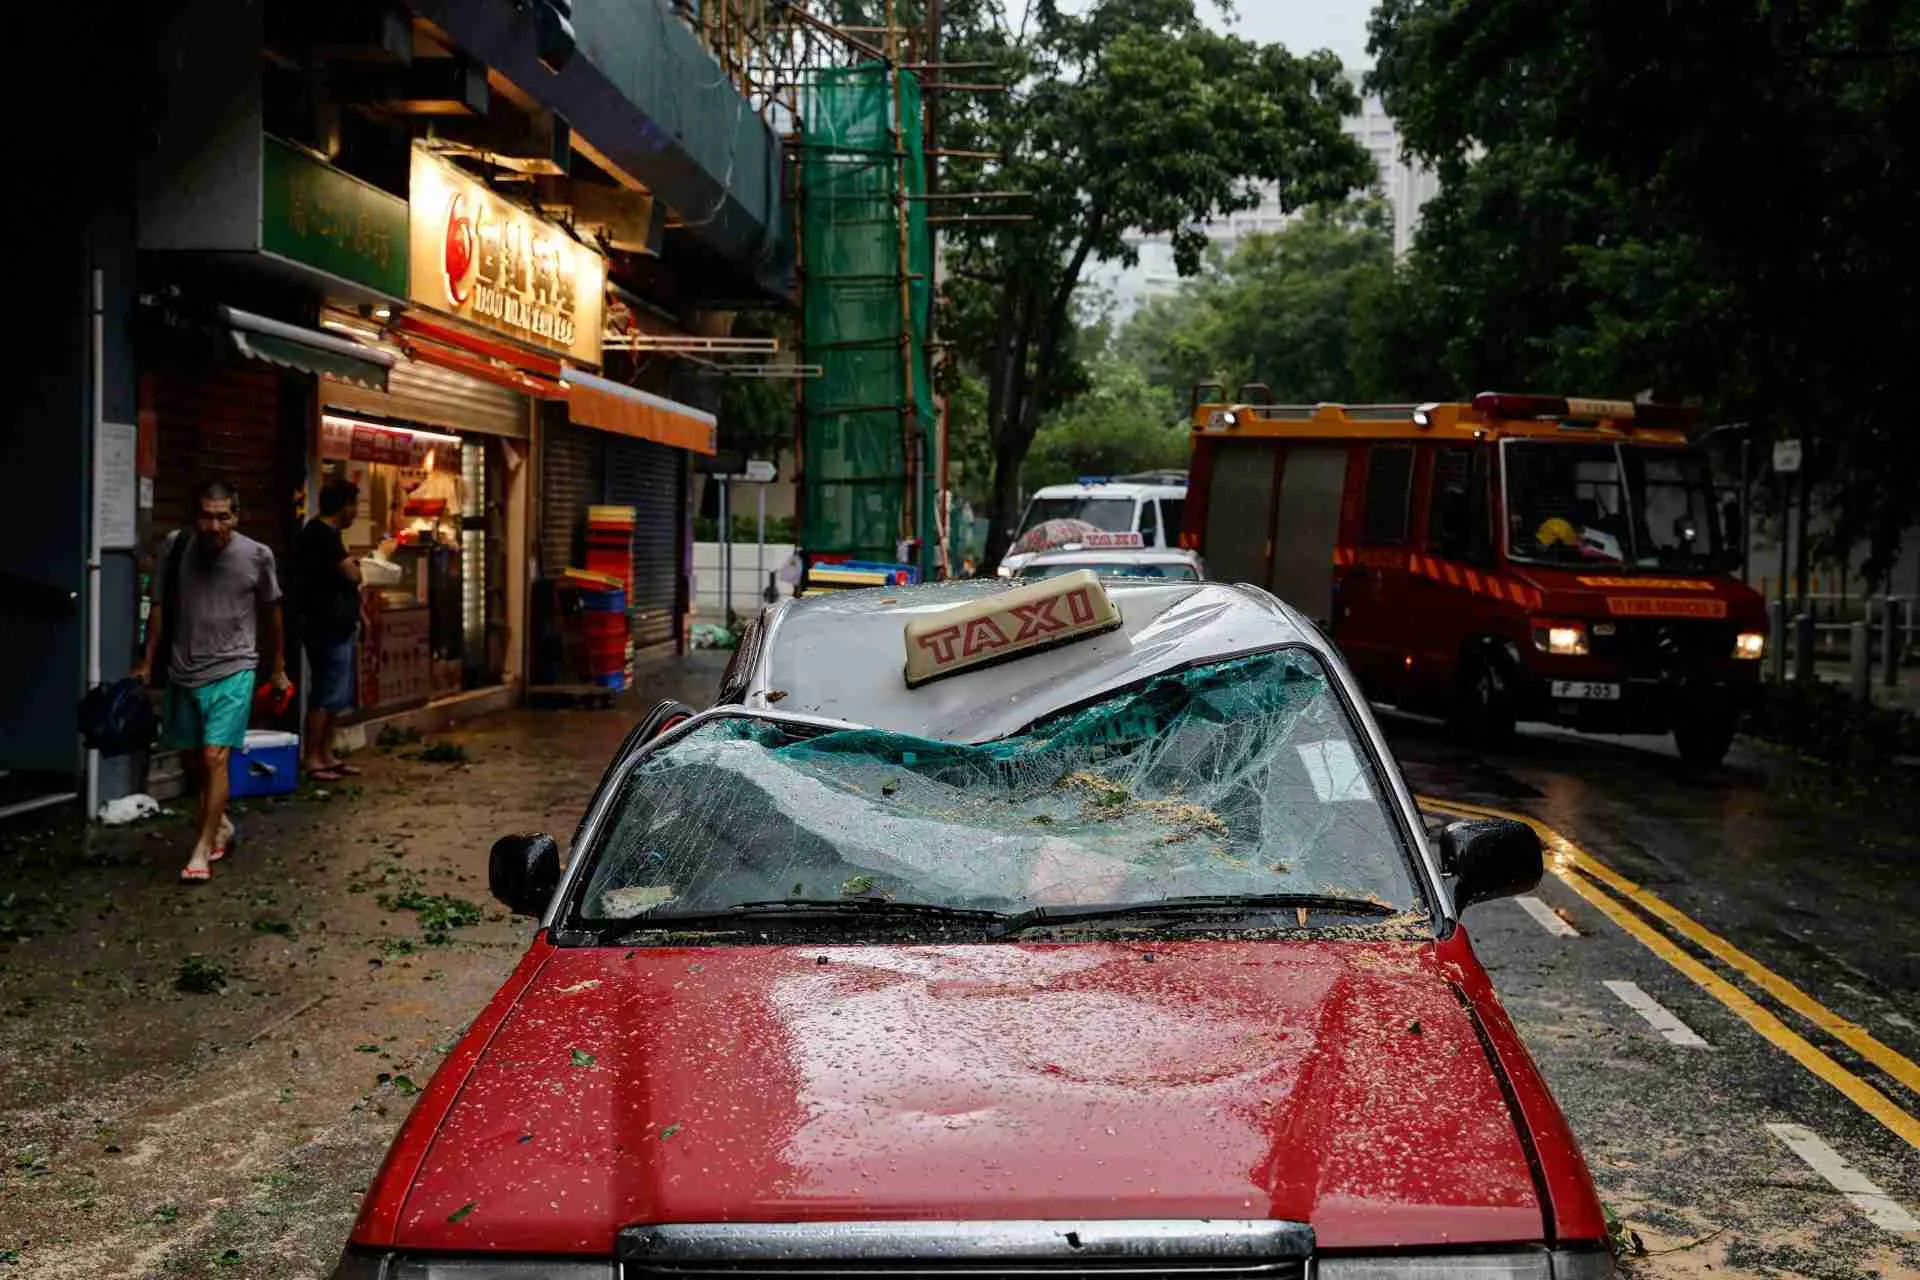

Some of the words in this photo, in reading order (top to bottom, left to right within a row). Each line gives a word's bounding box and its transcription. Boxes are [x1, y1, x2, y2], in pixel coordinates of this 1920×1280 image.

[1086, 534, 1138, 546] TAXI
[917, 588, 1095, 664] TAXI
[1562, 682, 1571, 696] F
